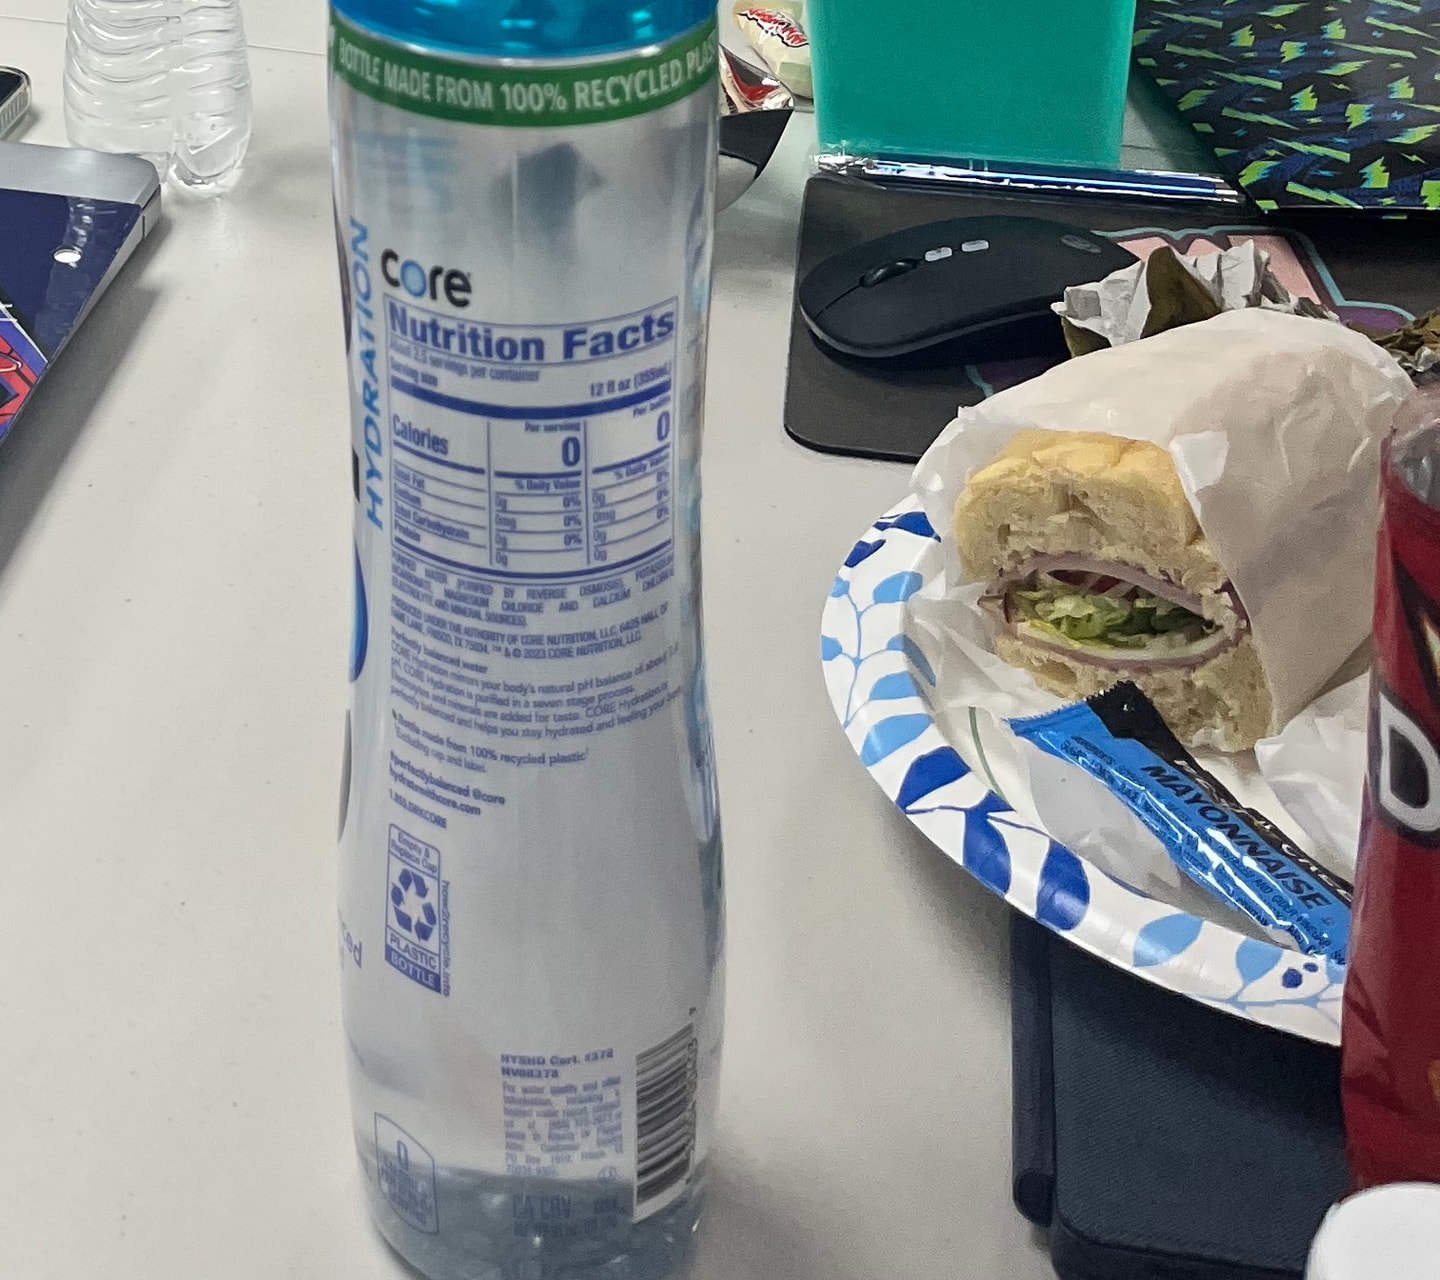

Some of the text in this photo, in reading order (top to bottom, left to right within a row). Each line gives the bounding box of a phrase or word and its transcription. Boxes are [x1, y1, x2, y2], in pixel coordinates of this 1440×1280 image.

[339, 37, 379, 85] BOTTLE
[383, 60, 431, 100] MADE
[435, 74, 494, 112] FROM
[500, 81, 567, 114] 100%
[573, 61, 683, 111] RECYCLED
[381, 248, 472, 309] core
[388, 301, 674, 361] Nutrition Facts
[350, 216, 384, 531] HYDRATION
[471, 365, 486, 379] per
[489, 367, 540, 382] container
[590, 381, 603, 397] 12
[618, 378, 630, 391] oz
[392, 413, 449, 455] Calories
[656, 410, 670, 443] 0
[562, 436, 581, 467] 0
[626, 462, 648, 479] Daily
[527, 480, 550, 492] Daily
[553, 479, 580, 490] Value
[563, 494, 582, 508] 0%
[564, 515, 582, 527] 0%
[564, 534, 582, 547] 0%
[501, 601, 545, 613] CHLORIDE
[559, 600, 580, 613] AND
[592, 588, 632, 609] CALCIUM
[526, 588, 567, 600] REVERSE
[520, 634, 545, 646] CORE
[523, 648, 546, 659] 2023
[547, 646, 574, 659] CORE
[462, 661, 489, 674] water
[538, 681, 575, 694] natural
[577, 679, 594, 694] pH
[595, 670, 633, 688] balance
[475, 693, 510, 708] purified
[532, 699, 563, 708] seven
[566, 696, 595, 708] stage
[500, 711, 533, 723] added
[534, 712, 550, 723] for
[585, 702, 617, 719] CORE
[473, 719, 499, 737] helps
[500, 726, 519, 738] you
[521, 727, 542, 740] stay
[544, 722, 594, 740] hydrated
[596, 716, 616, 731] and
[446, 737, 467, 755] from
[470, 745, 498, 762] 100%
[499, 752, 547, 768] recycled
[1139, 764, 1331, 911] MAYONNAISE
[389, 931, 437, 970] PLASTIC
[390, 950, 436, 988] BOTTLE
